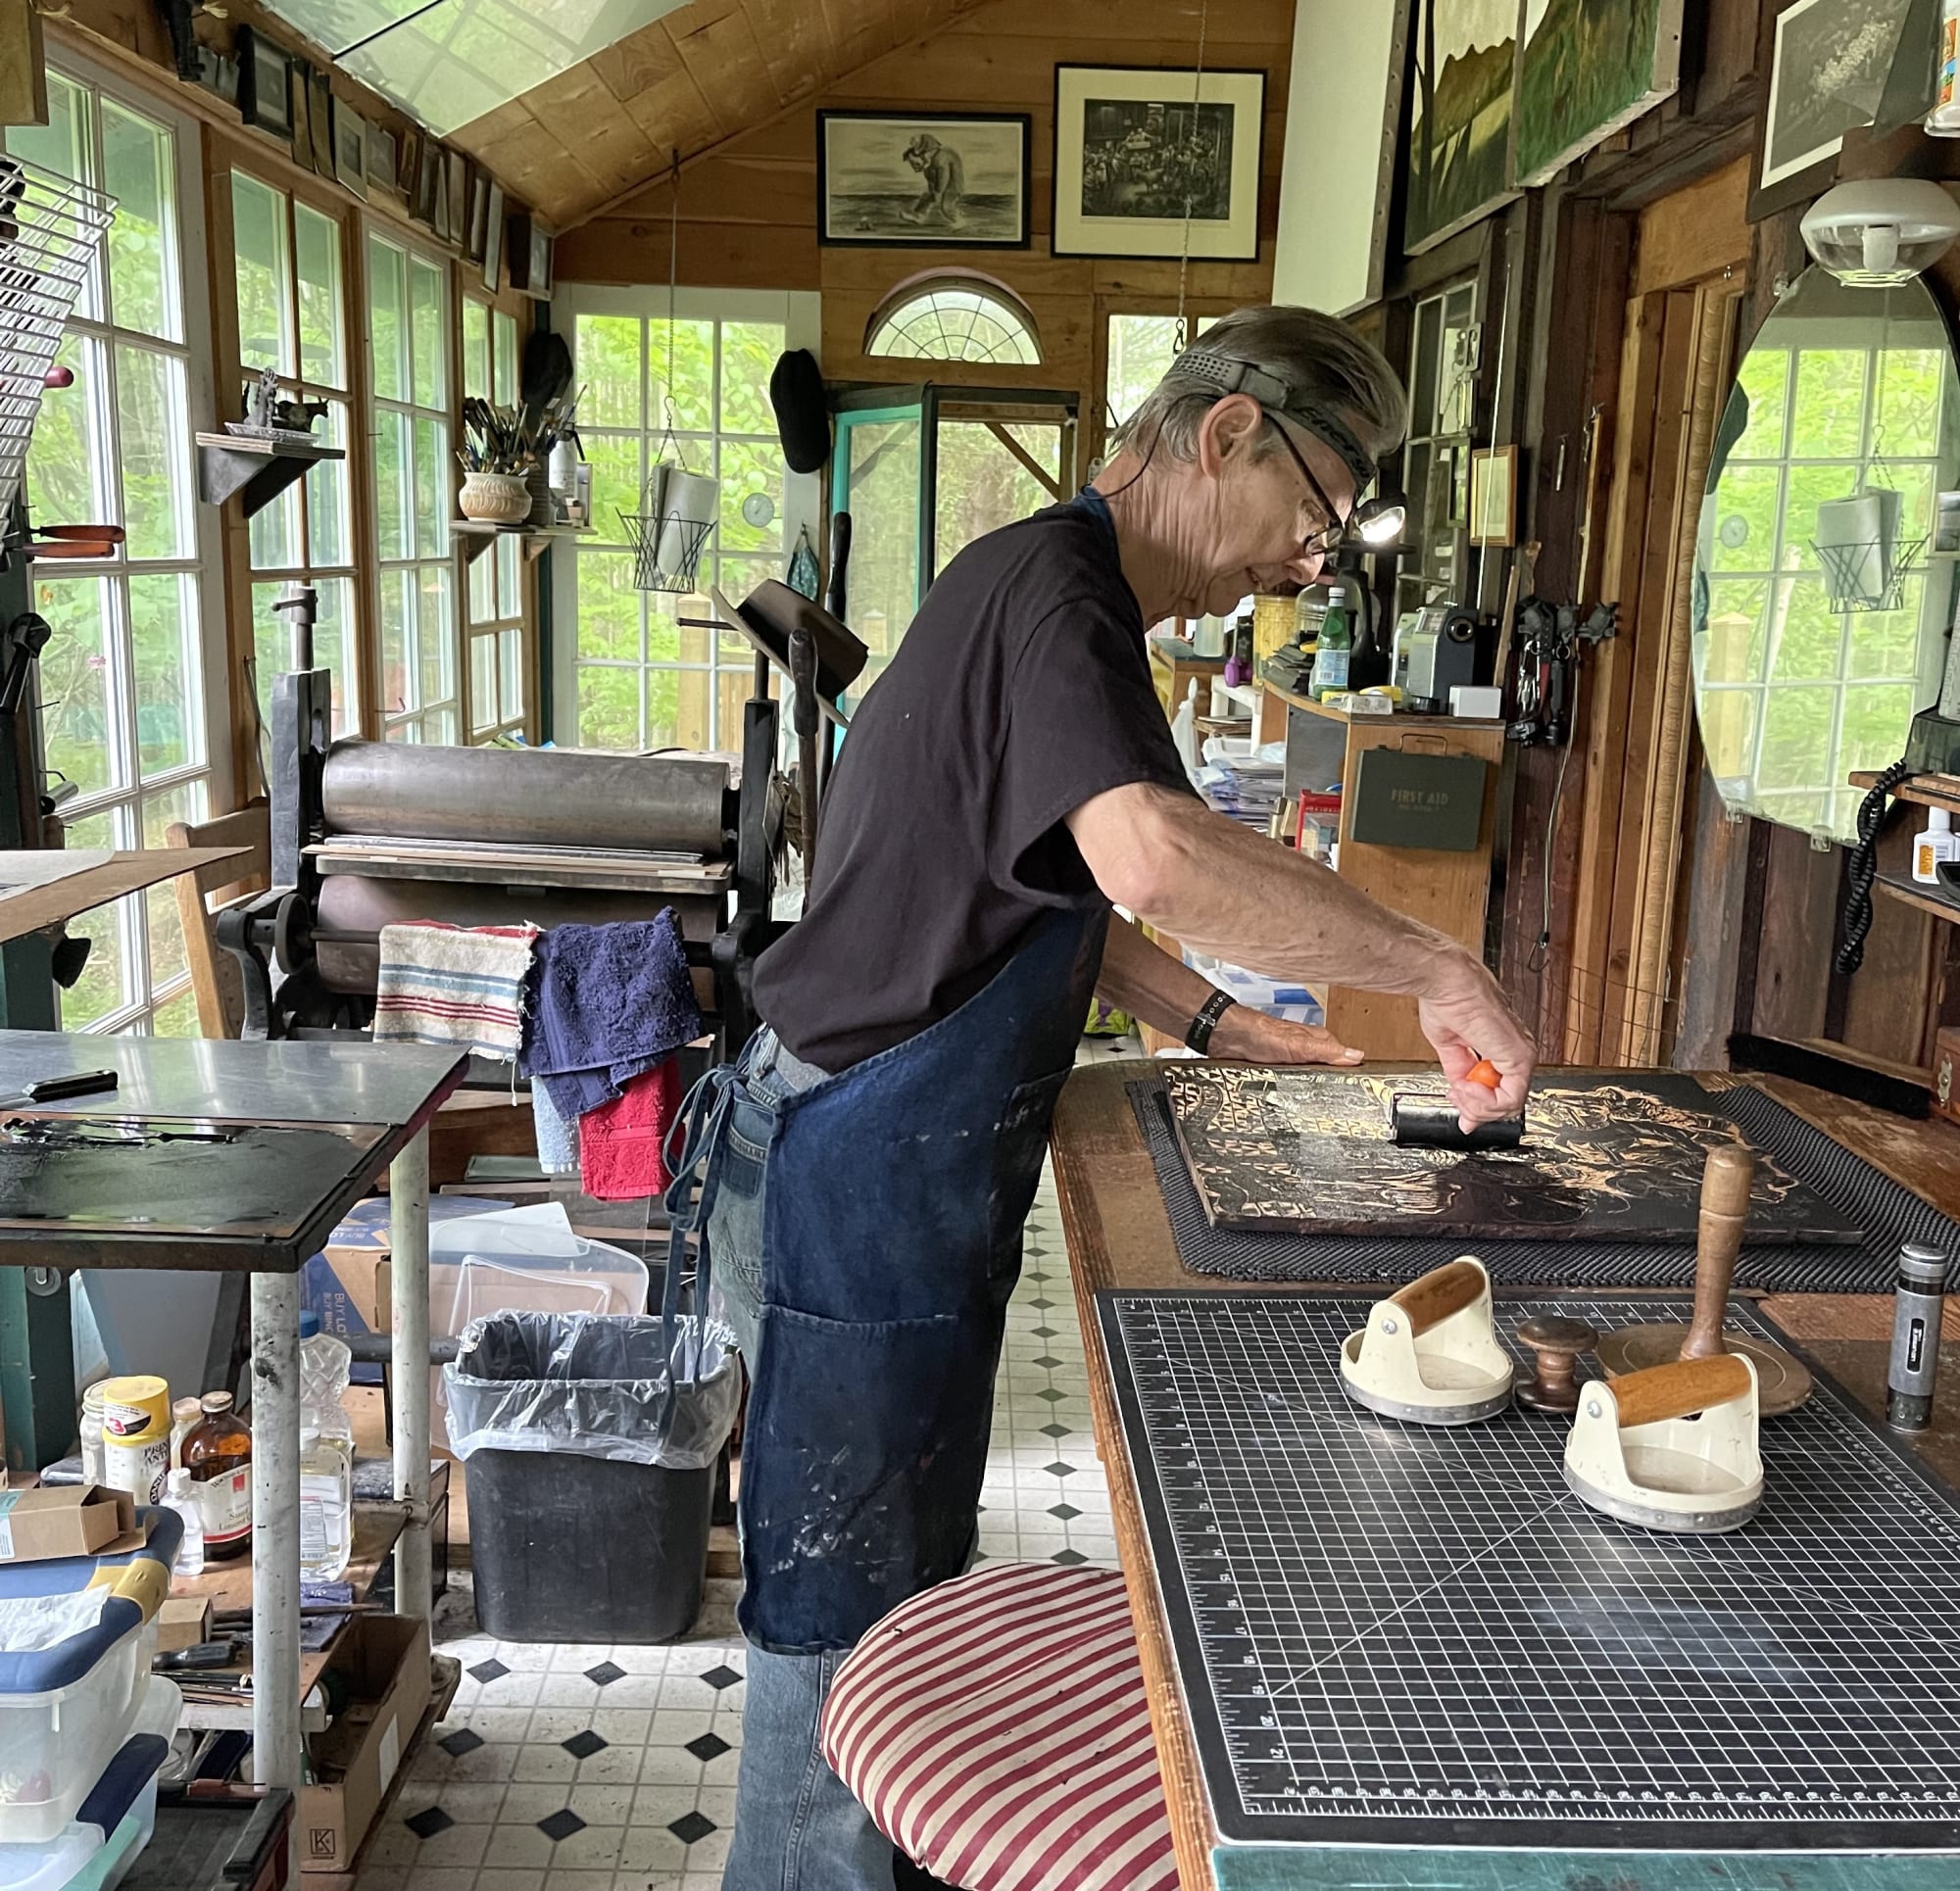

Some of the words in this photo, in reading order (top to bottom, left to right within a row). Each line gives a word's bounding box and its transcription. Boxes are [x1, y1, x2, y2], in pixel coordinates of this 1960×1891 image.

[1392, 789, 1423, 803] FIRST
[1427, 792, 1448, 805] AID
[334, 1292, 345, 1316] BUY
[1199, 1502, 1209, 1511] 12
[1205, 1525, 1217, 1533] 13
[1212, 1548, 1224, 1557] 14
[1219, 1573, 1231, 1582] 15
[1227, 1599, 1240, 1608] 16
[1235, 1626, 1248, 1635] 17
[1243, 1655, 1256, 1665] 18
[1251, 1684, 1265, 1695] 19
[1259, 1715, 1275, 1727] 20
[1269, 1748, 1284, 1759] 21
